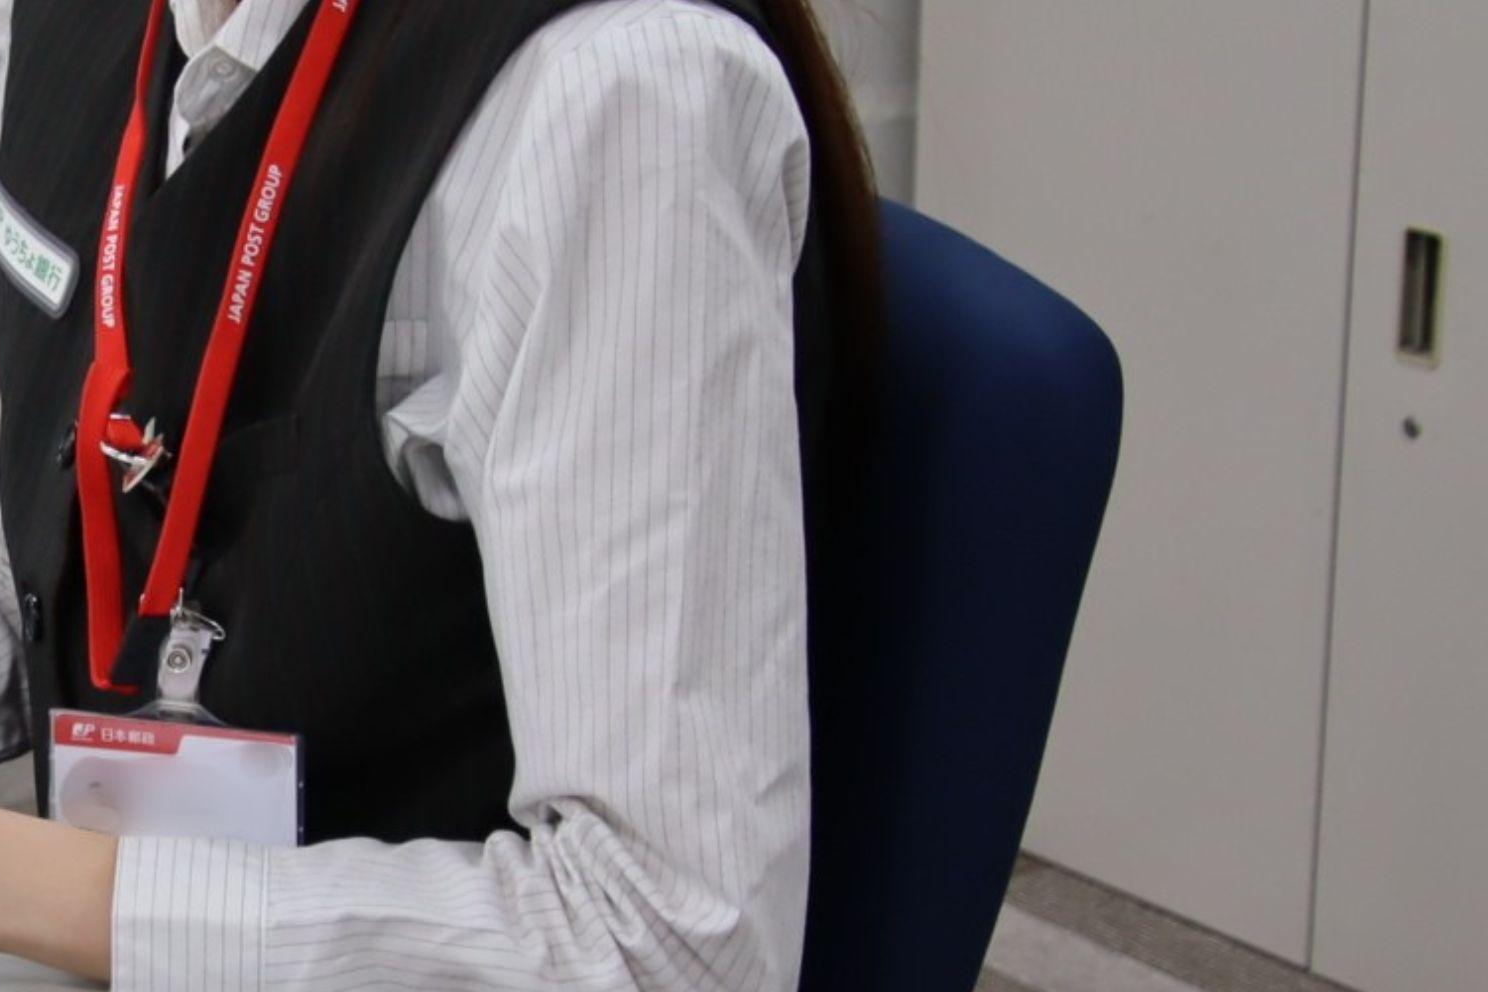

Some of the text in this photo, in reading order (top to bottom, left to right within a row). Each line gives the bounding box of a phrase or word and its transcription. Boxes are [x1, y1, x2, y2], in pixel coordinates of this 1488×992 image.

[101, 184, 125, 328] JAPAN POST GROUP
[228, 164, 282, 324] JAPAN POST GROUP
